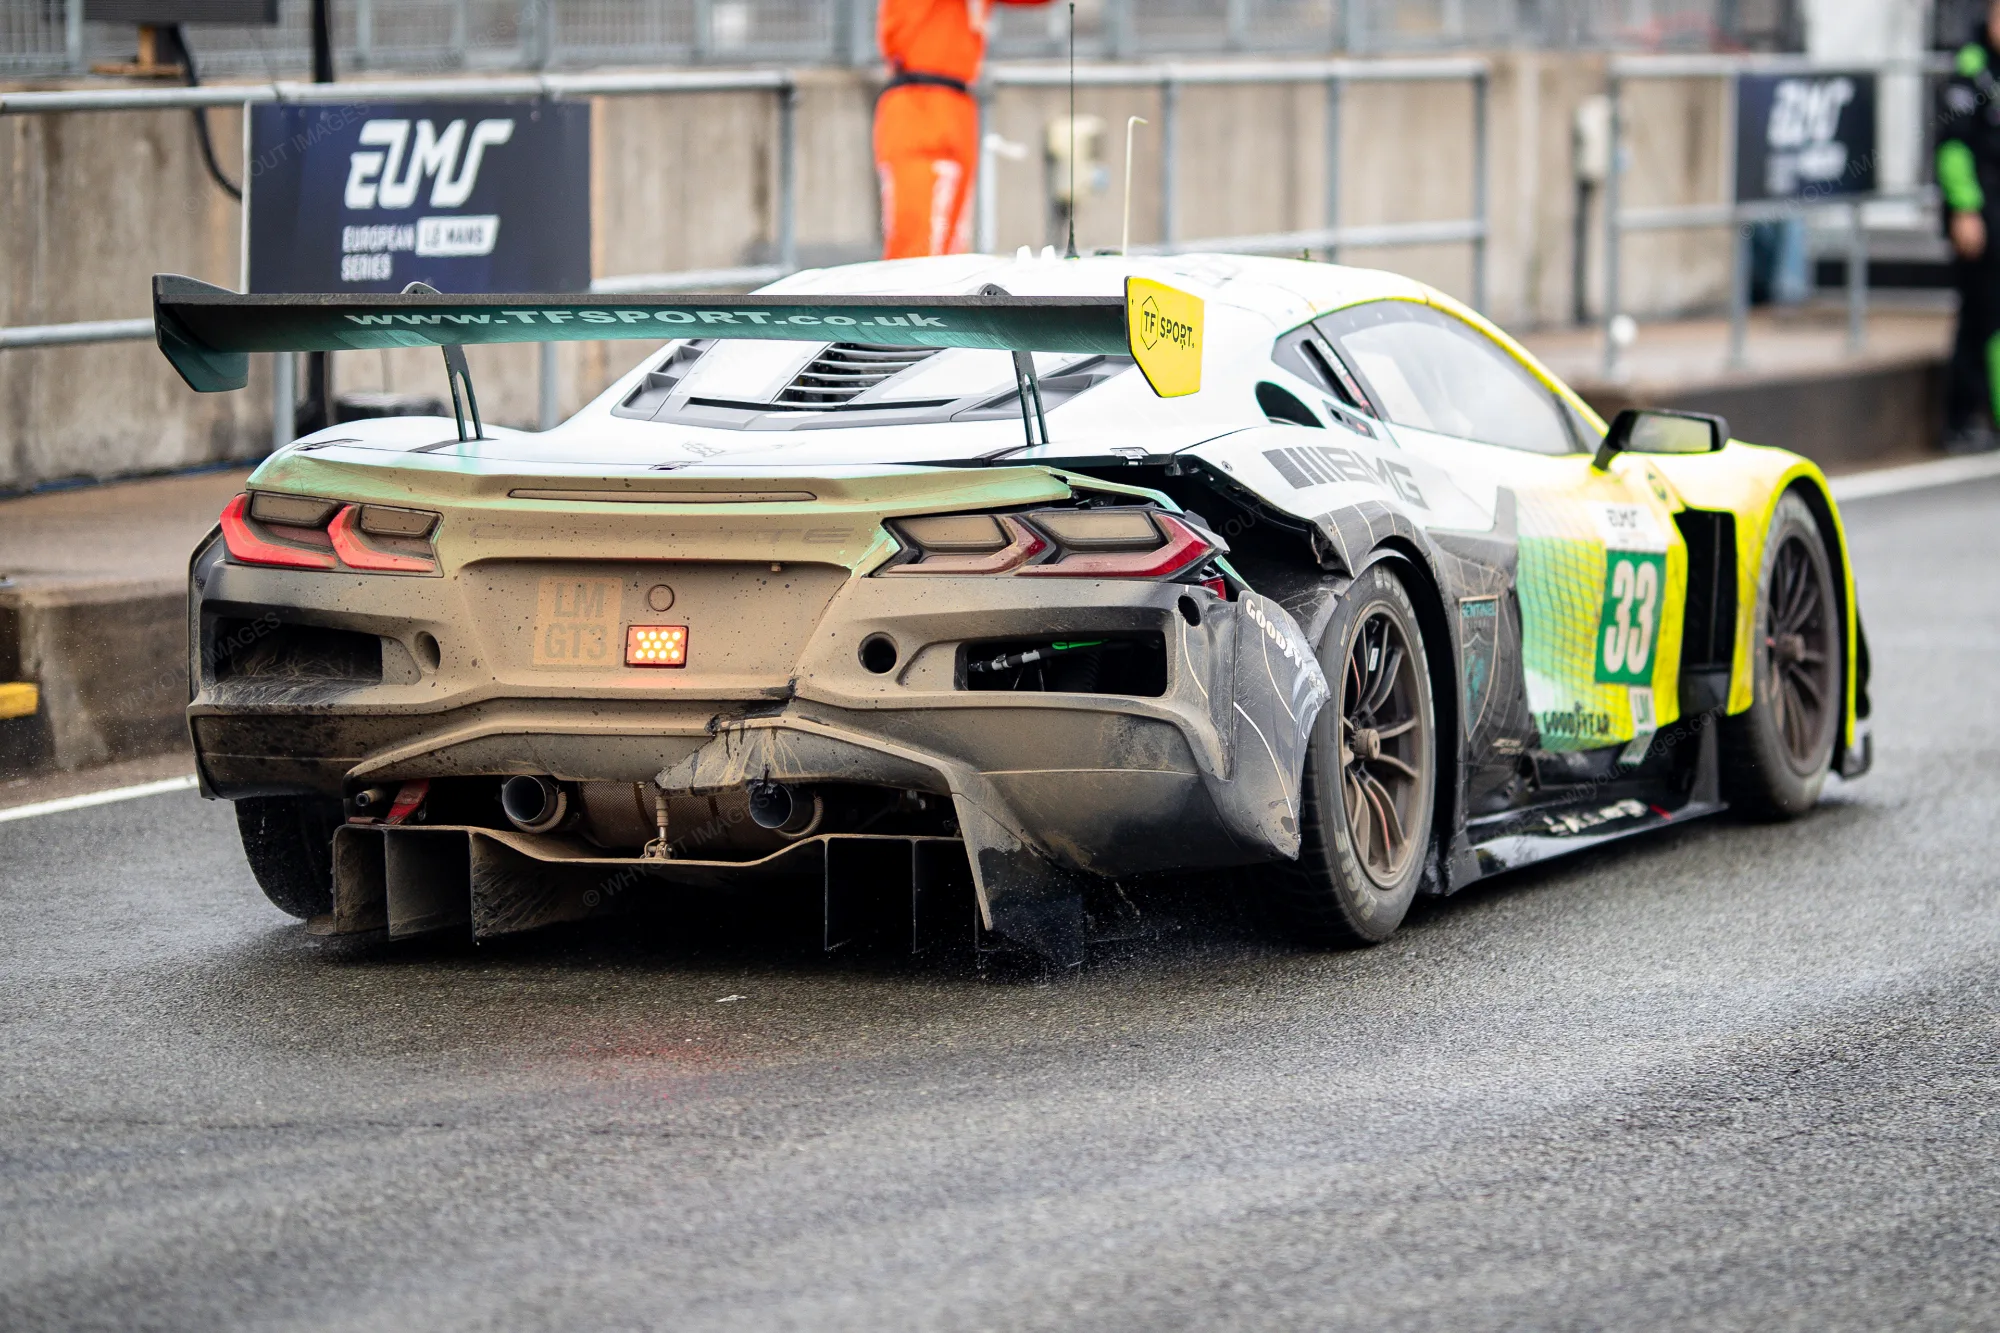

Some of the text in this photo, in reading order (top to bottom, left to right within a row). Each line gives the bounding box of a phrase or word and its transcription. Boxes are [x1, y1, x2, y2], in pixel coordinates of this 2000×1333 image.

[343, 224, 415, 253] EUROPEAN
[446, 225, 484, 246] MANS
[341, 253, 393, 282] SERIES
[346, 310, 948, 328] www.TFSPORT.co.uk
[1144, 311, 1156, 334] TF
[554, 582, 606, 618] LM
[1603, 559, 1658, 675] 33
[544, 622, 607, 659] GT3
[1543, 701, 1610, 739] GOODYEAR
